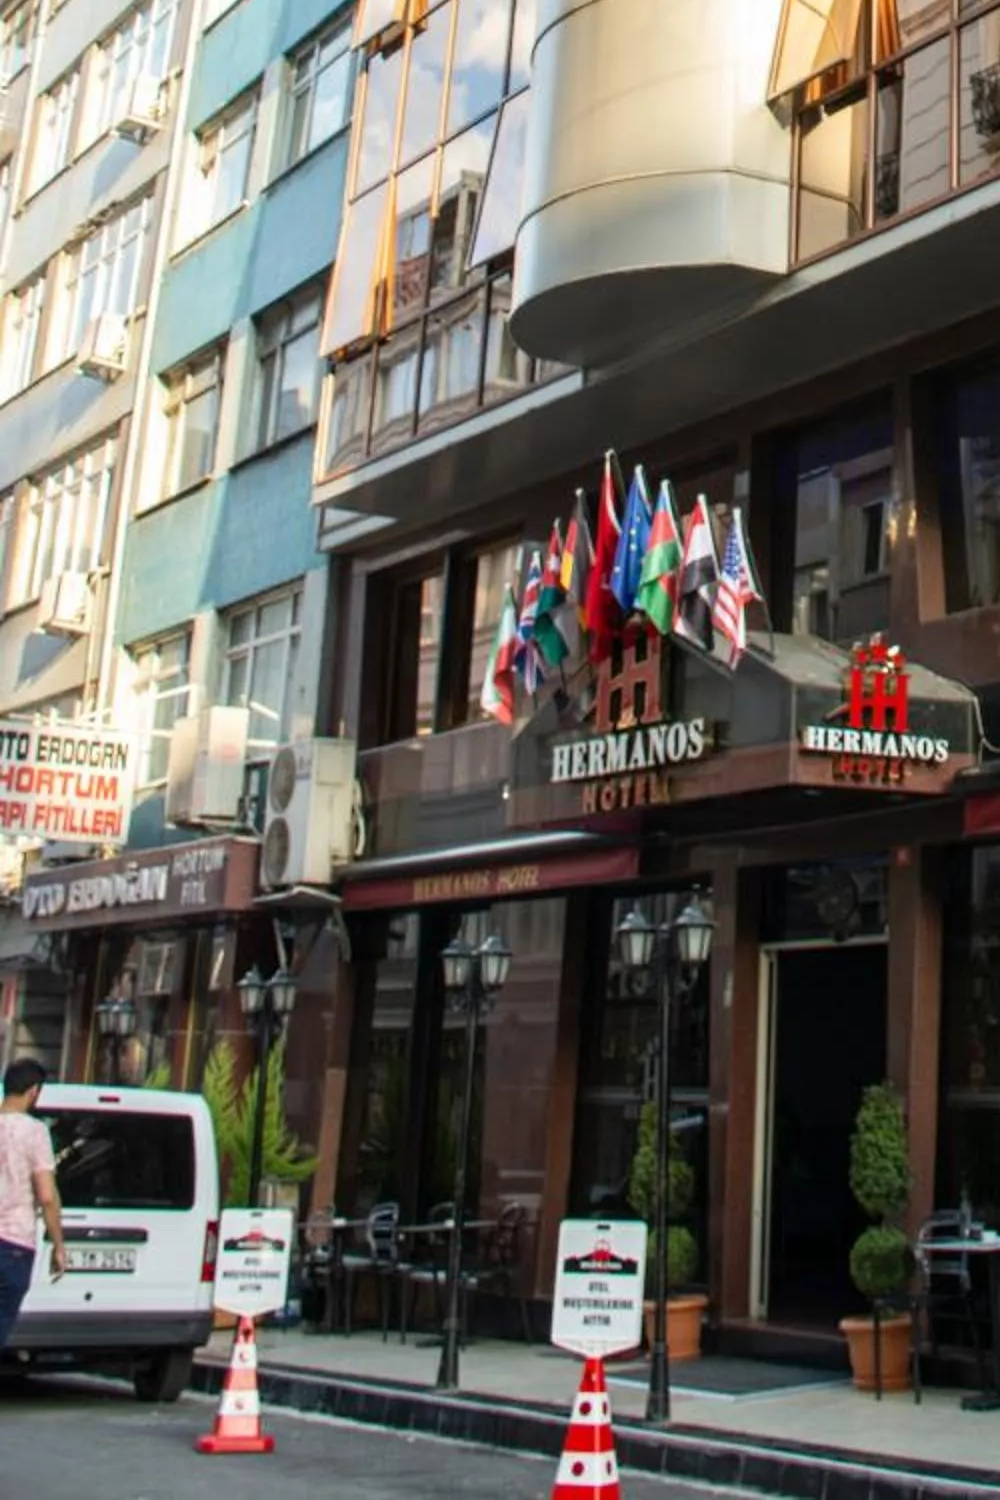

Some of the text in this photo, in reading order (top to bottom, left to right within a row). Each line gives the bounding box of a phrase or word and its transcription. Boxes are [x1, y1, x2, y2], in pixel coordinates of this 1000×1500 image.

[551, 718, 706, 783] HERMANOS
[804, 725, 949, 763] HERMANOS
[581, 771, 669, 814] HOTEL
